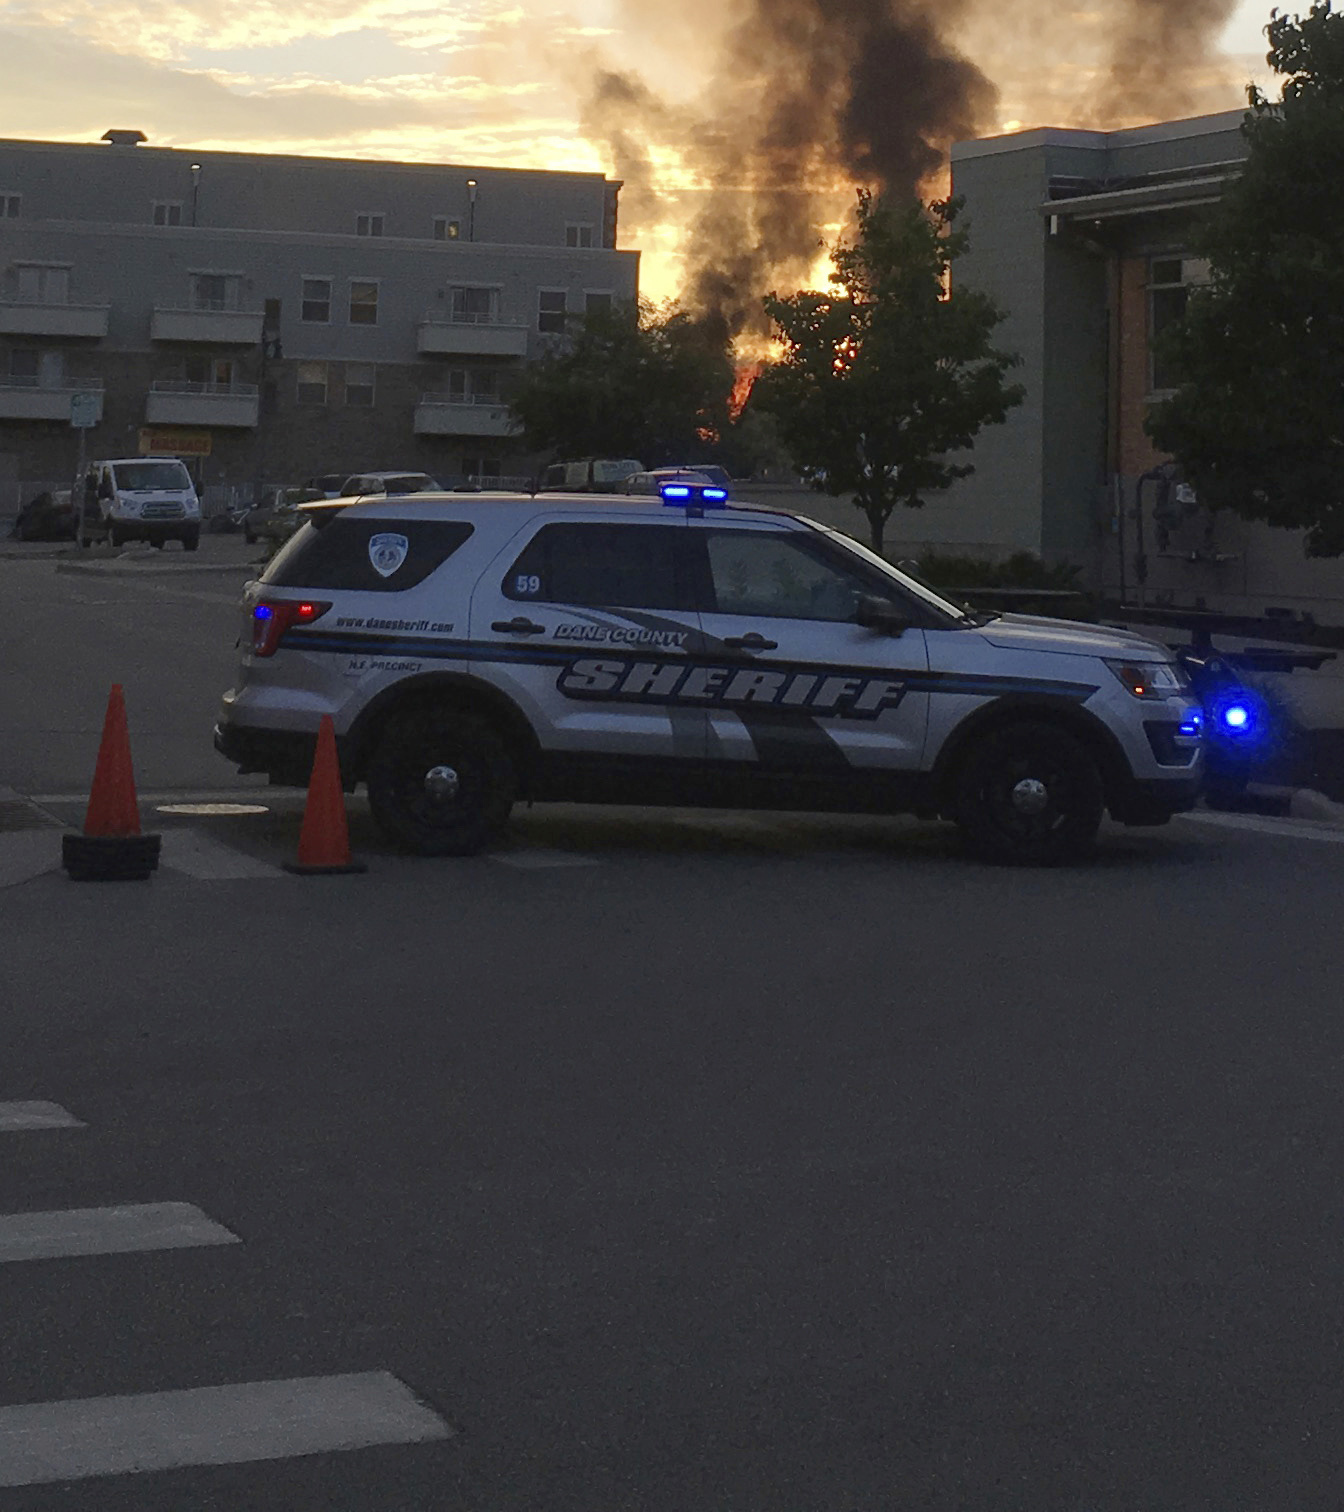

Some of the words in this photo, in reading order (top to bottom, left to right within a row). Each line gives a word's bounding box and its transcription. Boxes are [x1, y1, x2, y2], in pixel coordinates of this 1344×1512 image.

[516, 575, 541, 592] 59
[336, 616, 455, 633] www.danesheriff.com
[556, 623, 609, 640] DANE
[609, 628, 688, 647] COUNTY
[370, 661, 423, 672] PRECINCT
[559, 658, 907, 716] SHERIFF
